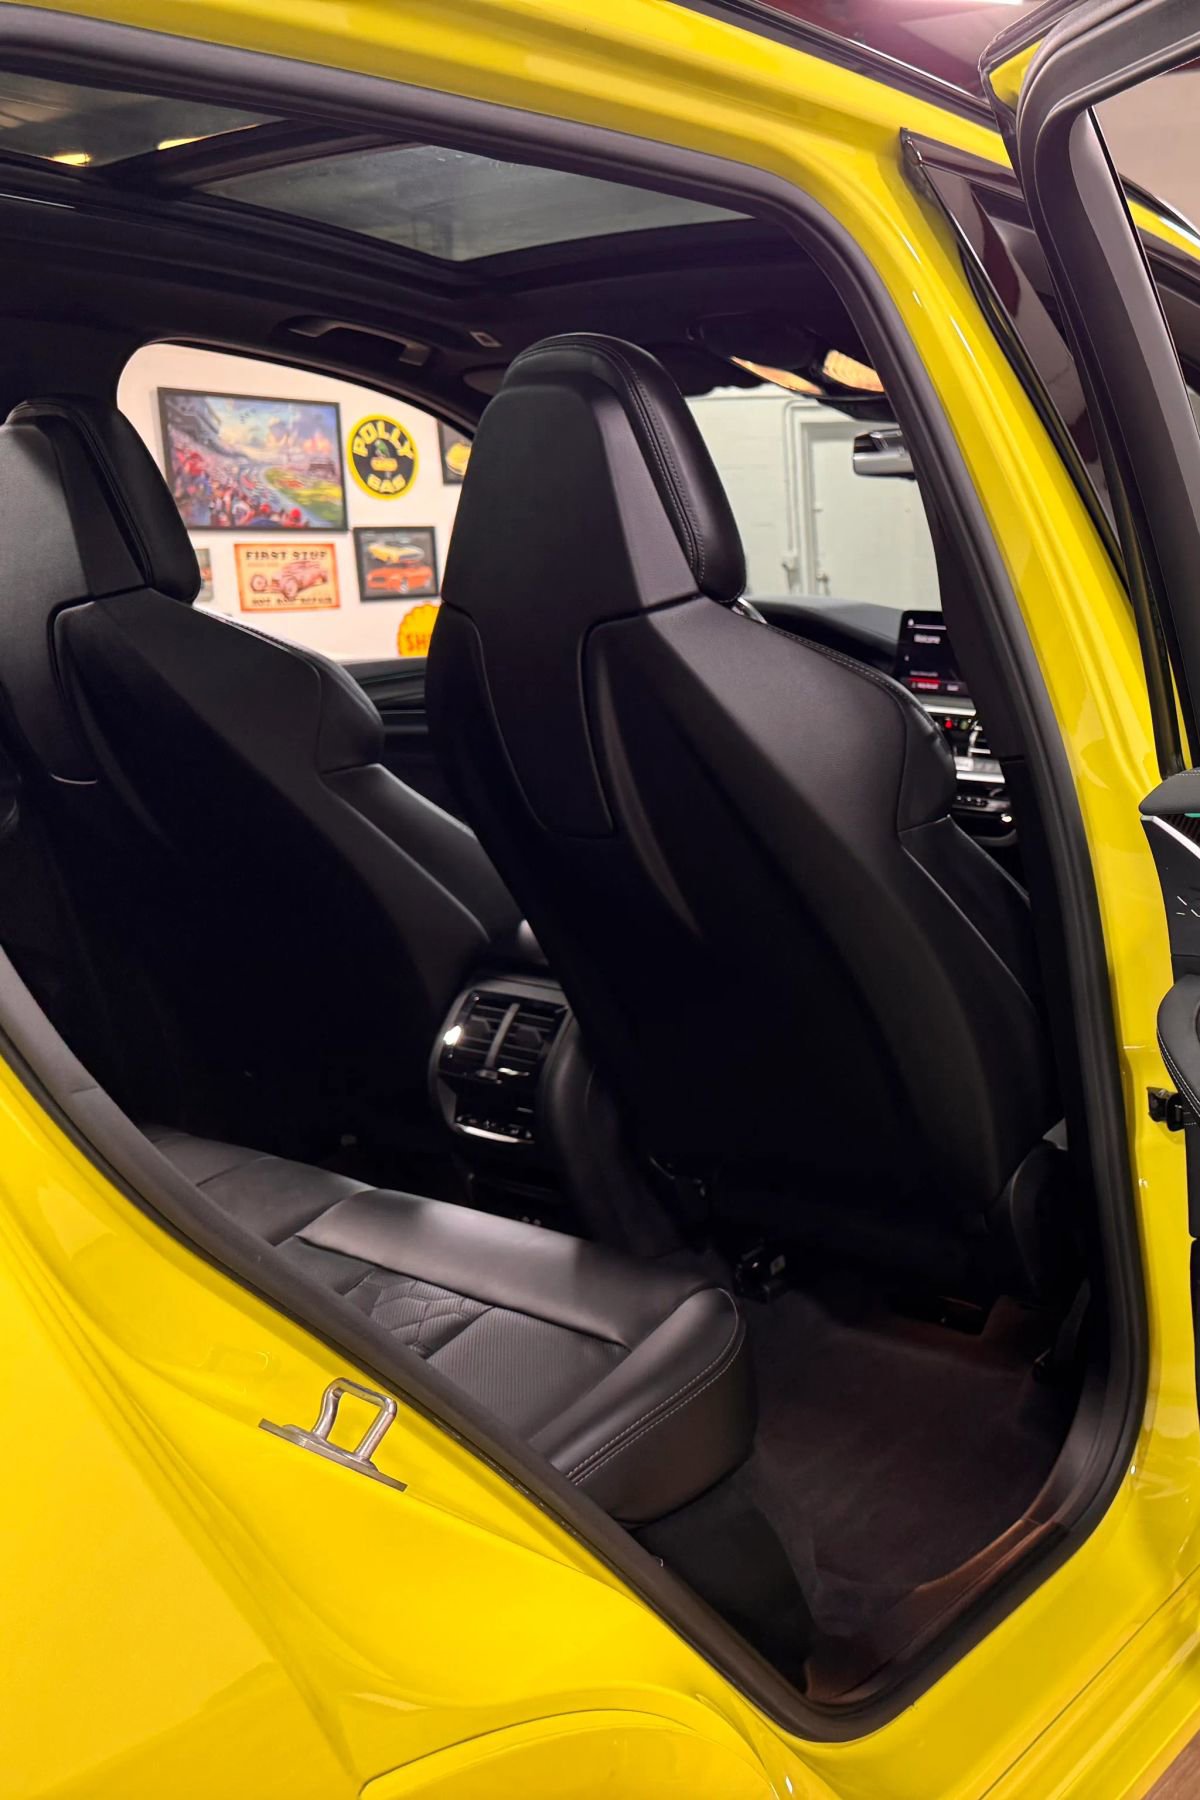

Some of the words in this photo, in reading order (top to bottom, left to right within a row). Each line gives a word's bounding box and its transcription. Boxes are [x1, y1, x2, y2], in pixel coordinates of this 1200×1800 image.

[353, 420, 415, 460] POLLY
[367, 473, 407, 494] GAS
[246, 551, 287, 560] FIRST
[405, 633, 430, 652] SH
